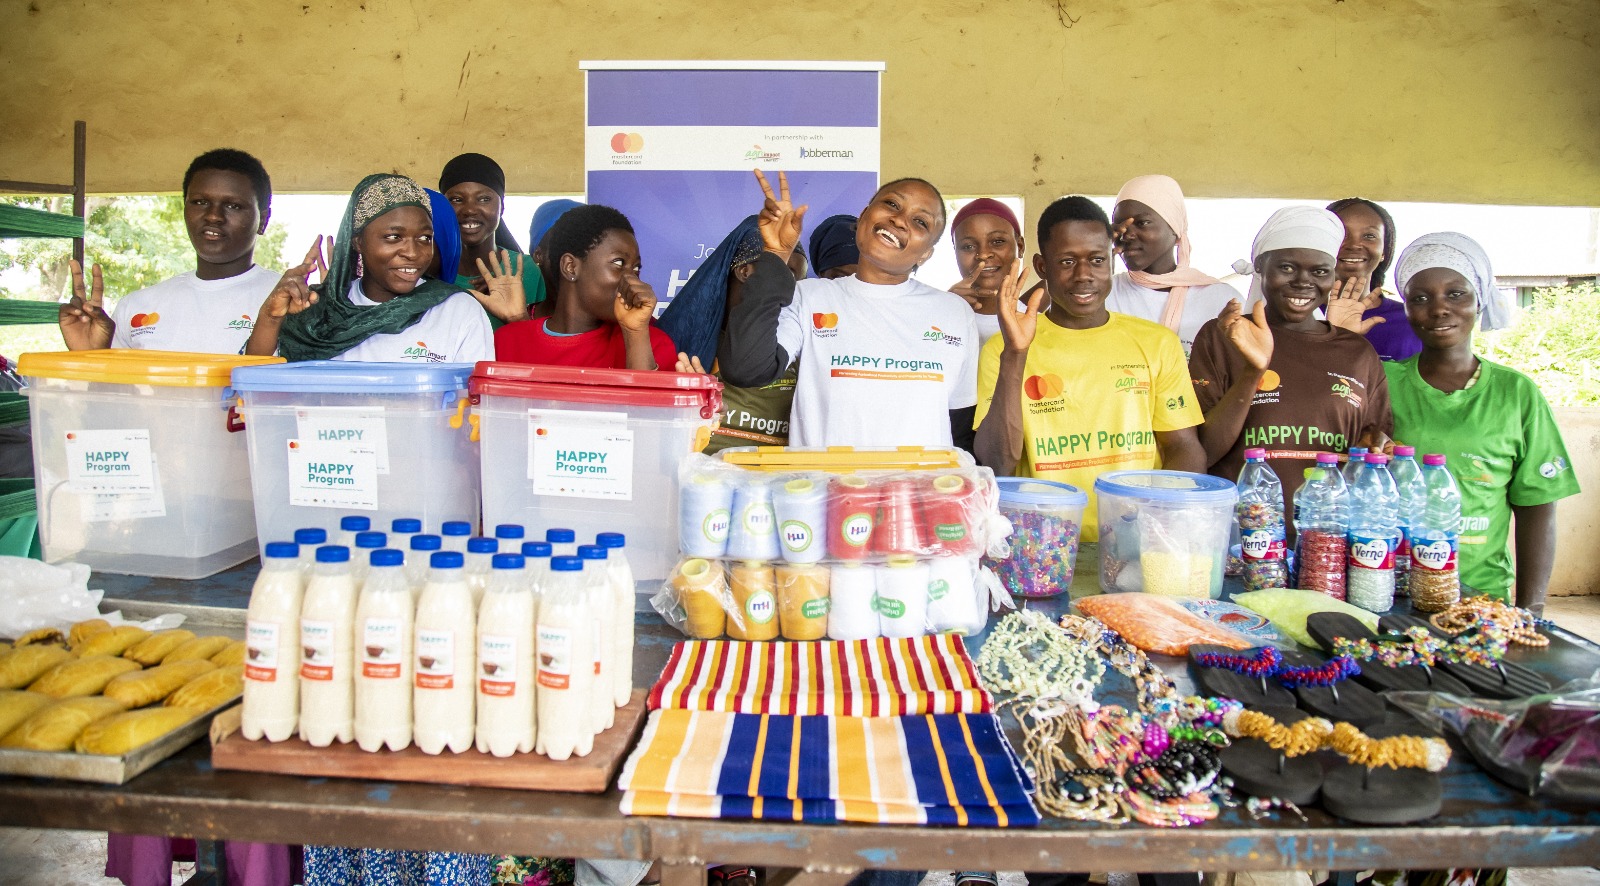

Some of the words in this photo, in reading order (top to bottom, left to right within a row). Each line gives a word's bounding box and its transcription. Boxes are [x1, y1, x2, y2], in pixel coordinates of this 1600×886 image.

[772, 134, 809, 142] partnership
[830, 354, 881, 368] HAPPY
[884, 357, 944, 371] Program
[739, 411, 790, 435] Progra
[318, 429, 365, 441] HAPPY
[1245, 425, 1303, 446] HAPPY
[1035, 432, 1092, 457] HAPPY
[85, 451, 129, 462] HAPPY
[556, 449, 608, 464] HAPPY
[86, 462, 131, 473] Program
[308, 462, 354, 475] HAPPY
[556, 461, 607, 475] Program
[308, 473, 354, 486] Program
[1458, 515, 1490, 535] gram
[1242, 537, 1268, 551] Verna
[1354, 545, 1384, 561] Verna
[1416, 547, 1447, 562] Verna
